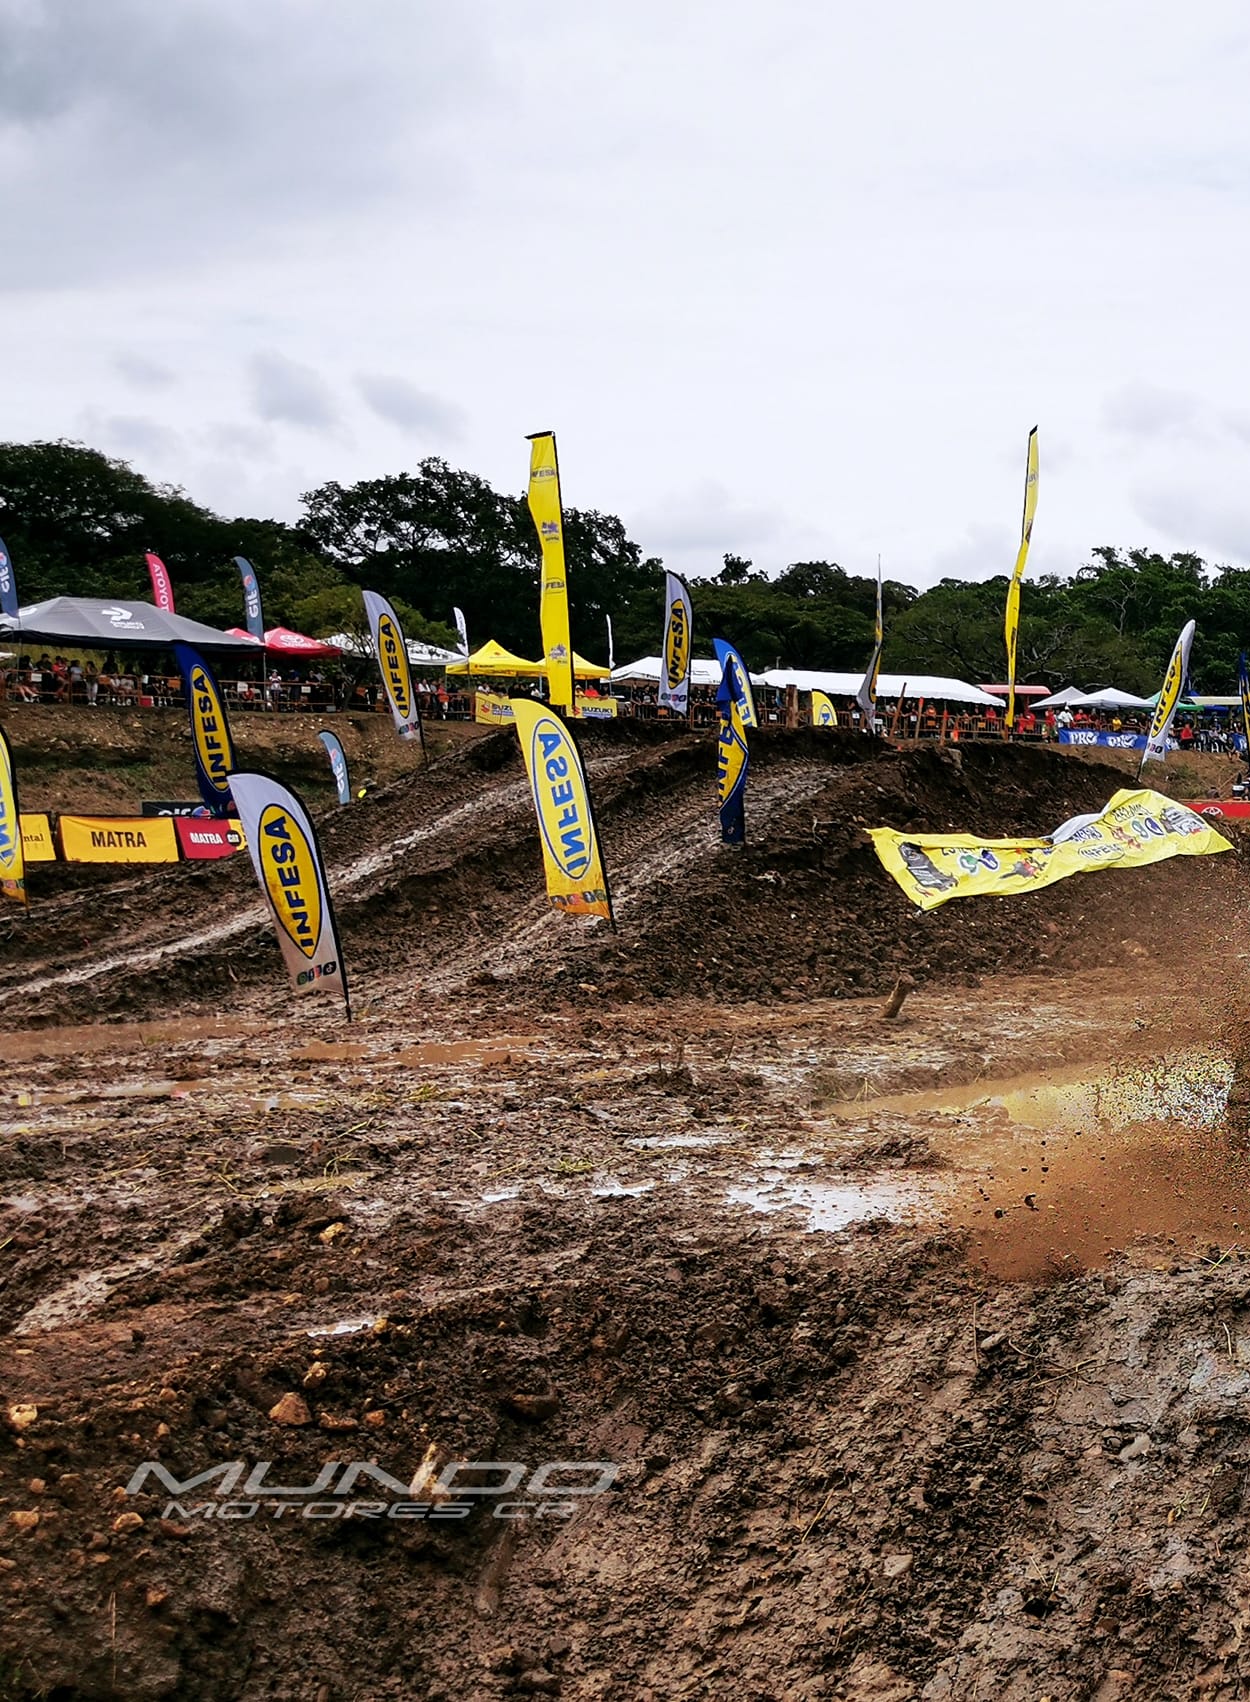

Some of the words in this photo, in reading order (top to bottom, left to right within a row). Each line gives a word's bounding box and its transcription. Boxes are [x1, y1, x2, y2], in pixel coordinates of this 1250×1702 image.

[381, 622, 408, 711] INFESA
[193, 674, 229, 785] INFESA
[91, 831, 147, 848] MATRA
[189, 832, 224, 844] MATRA
[263, 815, 314, 949] INFESA
